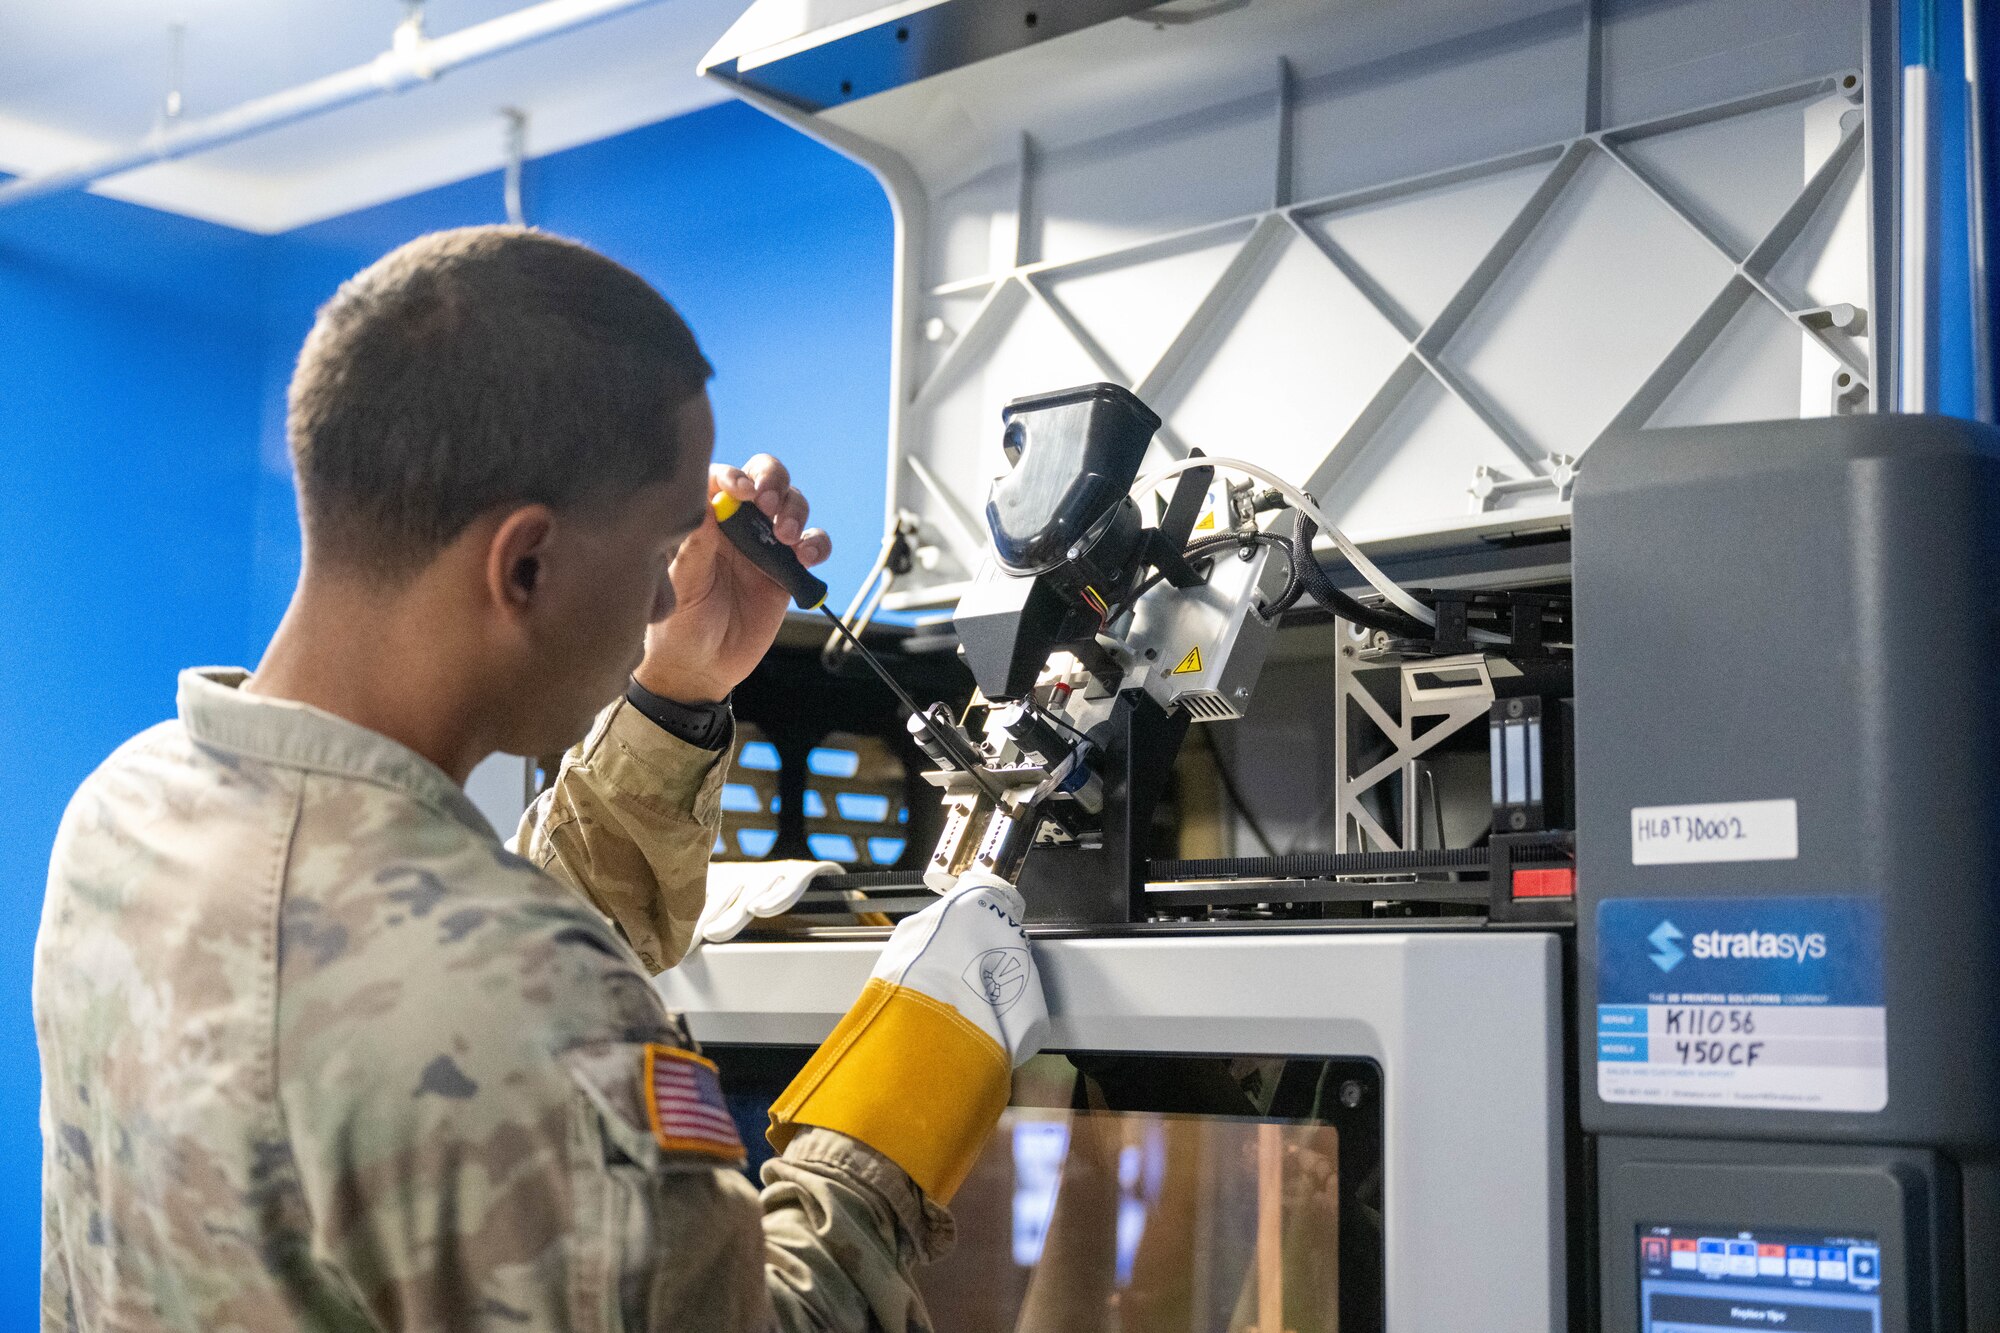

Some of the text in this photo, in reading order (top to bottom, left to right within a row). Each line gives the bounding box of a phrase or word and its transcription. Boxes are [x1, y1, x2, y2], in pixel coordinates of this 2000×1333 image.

[1692, 930, 1827, 964] stratasys
[1666, 1008, 1755, 1035] K11056
[1676, 1041, 1765, 1067] 450CF
